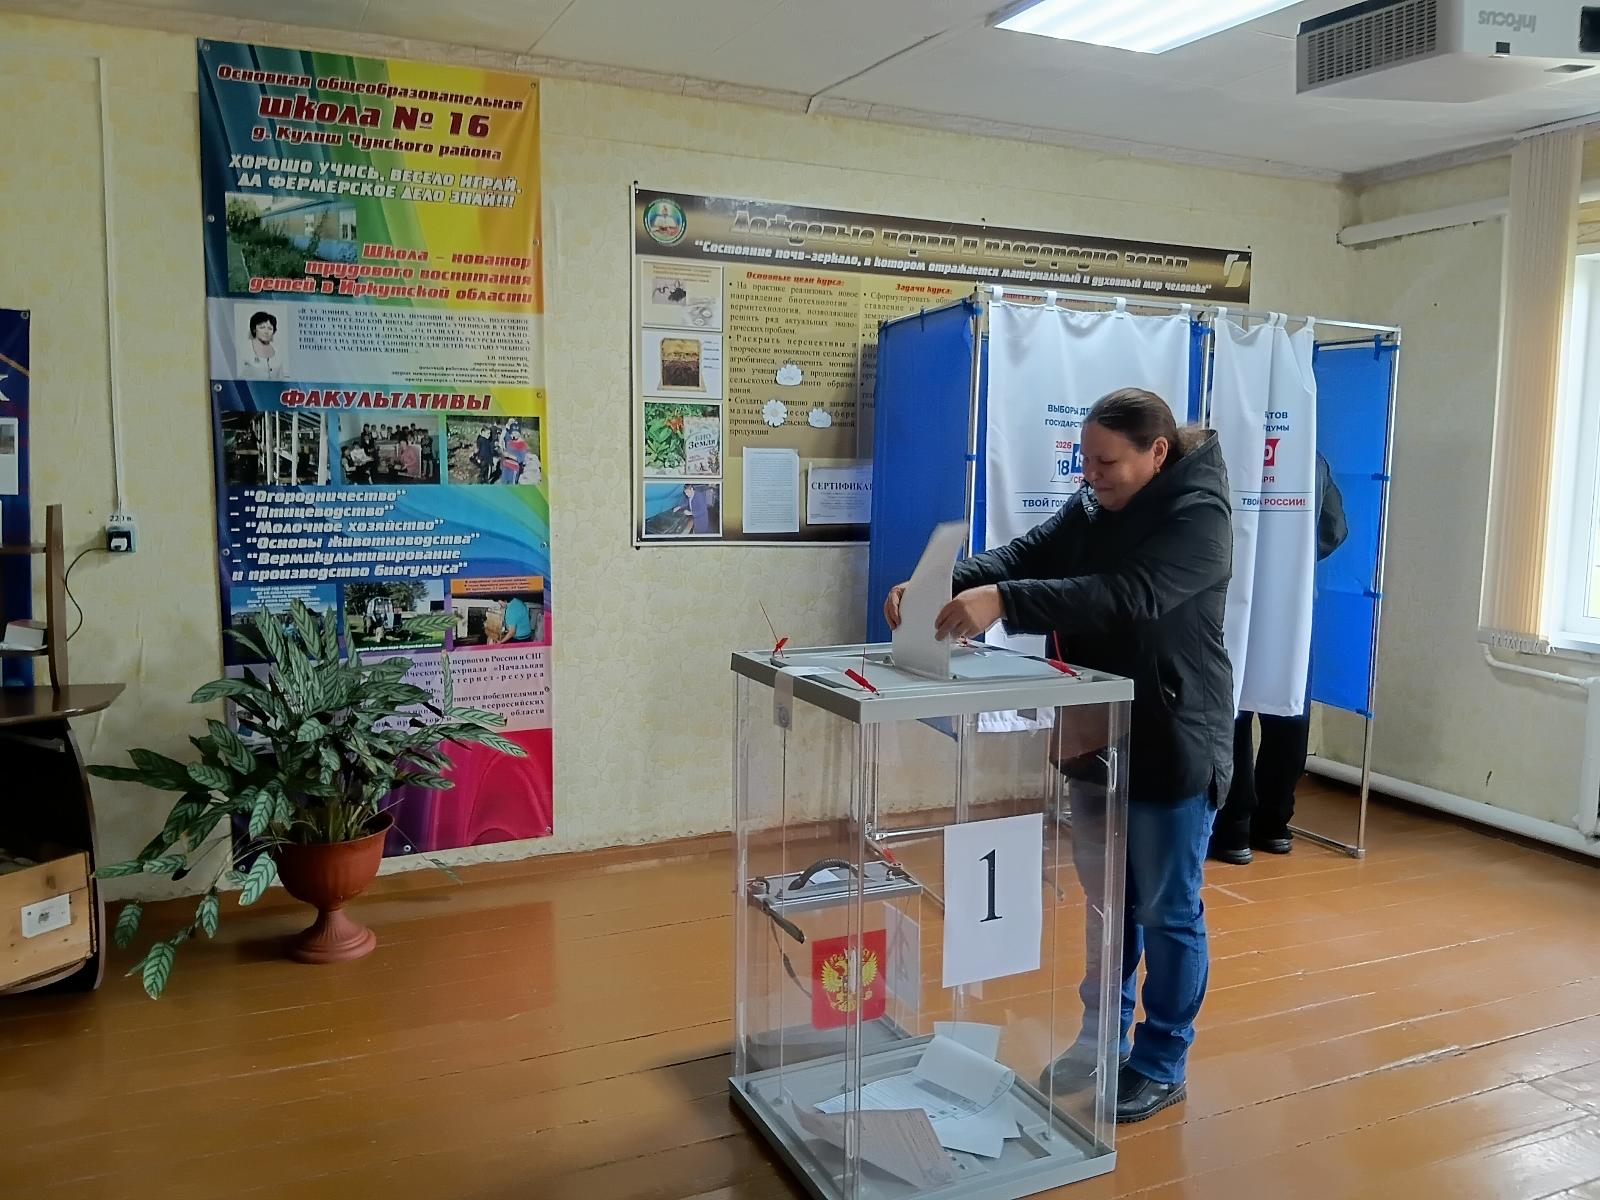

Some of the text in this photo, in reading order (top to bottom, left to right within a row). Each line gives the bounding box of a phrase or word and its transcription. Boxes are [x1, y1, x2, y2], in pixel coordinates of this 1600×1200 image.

[217, 65, 524, 111] Основная общеобразовательная
[392, 107, 435, 131] №
[449, 111, 491, 138] 16
[252, 126, 502, 161] д. Кулиш Чунского района
[229, 154, 313, 175] ХОРОШО
[318, 161, 385, 182] УЧИСЬ,
[391, 168, 455, 188] ВЕСЕЛО
[237, 173, 515, 209] ДА ФЕРМЕРСКОЕ ДЕЛО ЗНАЙ!!!
[362, 243, 429, 261] Школа
[451, 253, 531, 270] новатор
[305, 260, 532, 286] трудового воспитания
[746, 271, 792, 283] Основные
[793, 276, 815, 285] цели
[863, 256, 872, 267] в
[874, 256, 926, 272] котором
[928, 261, 1000, 277] отражается
[1001, 268, 1082, 284] материальный
[1091, 276, 1142, 290] духовный
[1142, 279, 1163, 292] мир
[249, 276, 533, 303] детей в Иркутской области
[895, 283, 926, 293] Задачи
[280, 389, 492, 411] ФАКУЛЬТАТИВЫ
[1055, 441, 1072, 449] 2026
[1057, 460, 1070, 476] 18
[1022, 498, 1049, 507] ТВОЙ
[1264, 498, 1306, 506] РОССИИ!
[232, 570, 243, 582] и
[248, 566, 370, 583] производство
[491, 655, 518, 663] России
[978, 848, 1003, 923] 1
